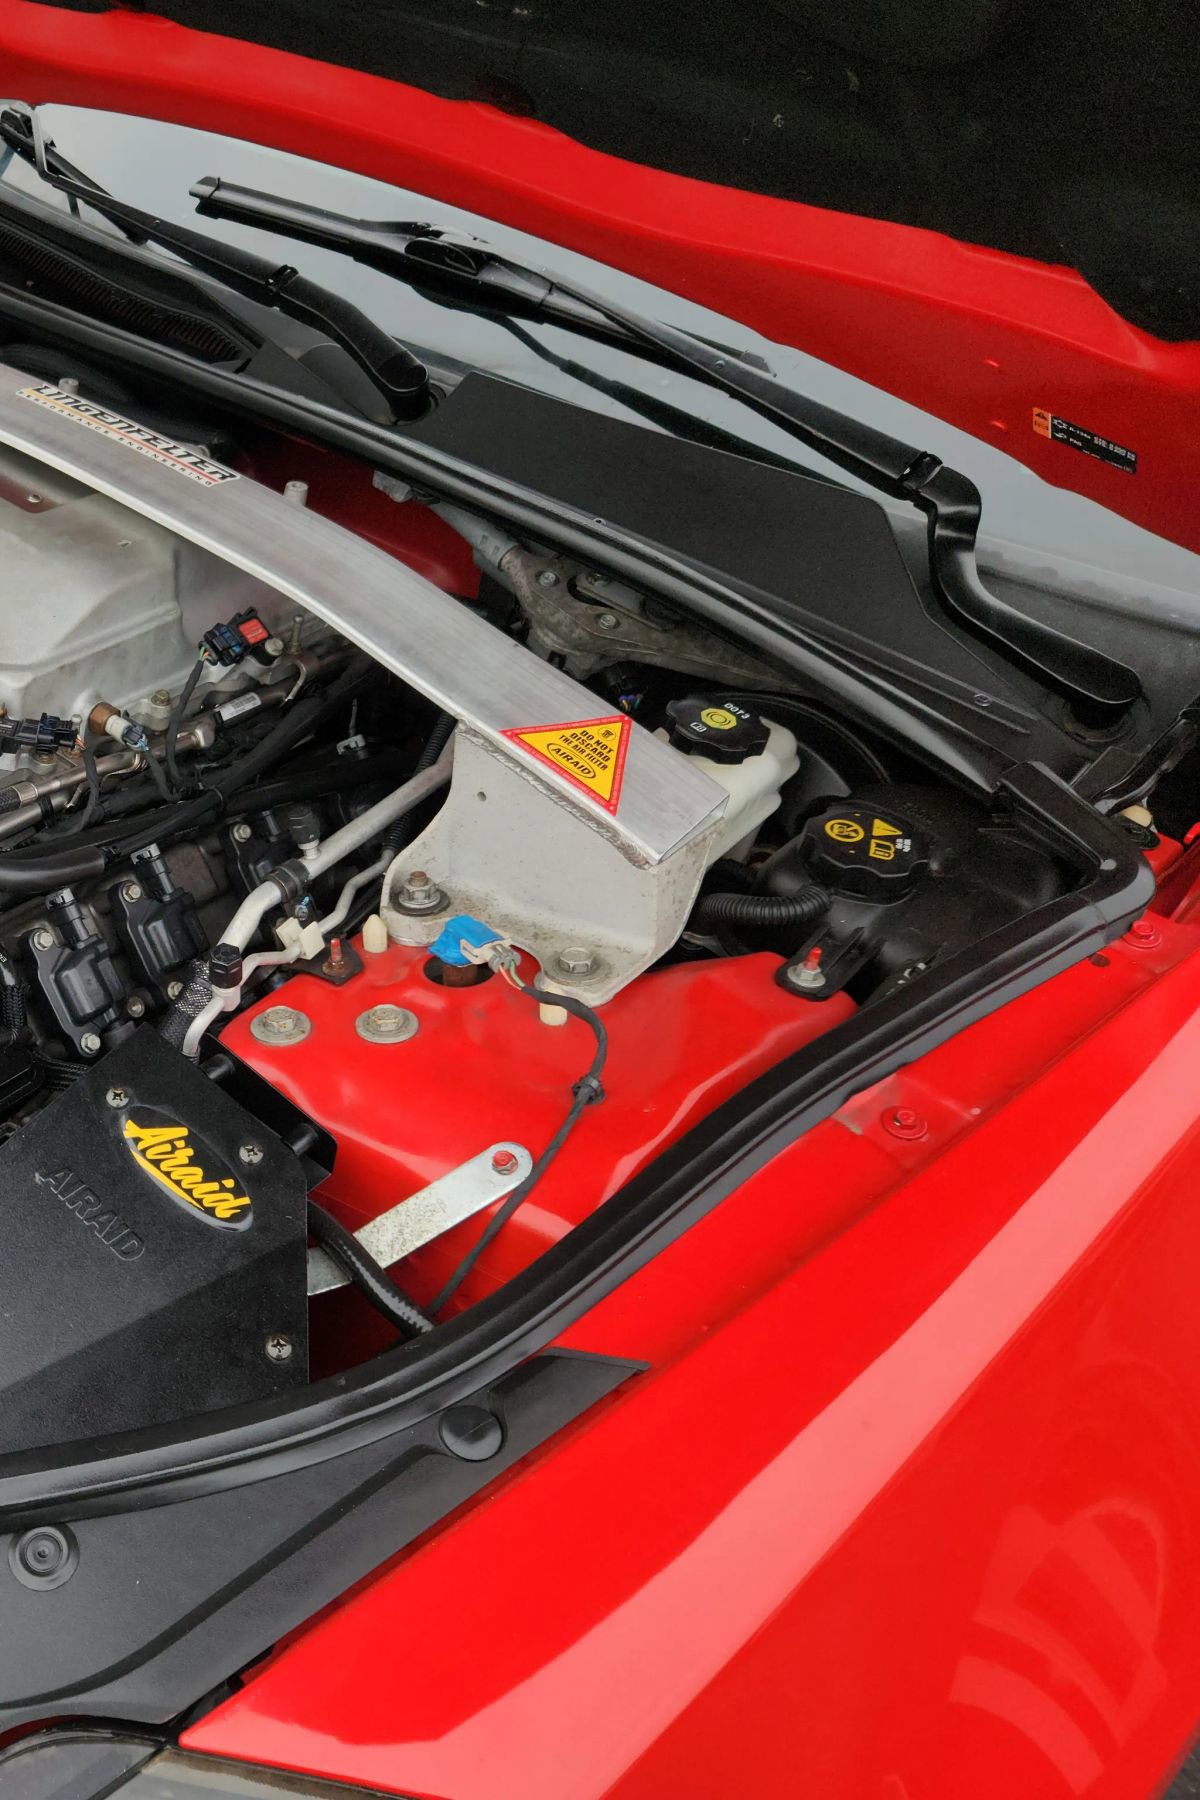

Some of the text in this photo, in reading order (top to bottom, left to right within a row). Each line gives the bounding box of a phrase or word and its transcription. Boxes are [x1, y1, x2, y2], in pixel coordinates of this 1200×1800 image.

[19, 391, 212, 485] PERFORMANCE ENGINEERING
[32, 385, 237, 480] LINGENFELTER
[551, 748, 592, 774] AIRAID
[559, 734, 608, 770] THE AIR FILTER
[570, 732, 610, 762] DISCARD
[580, 730, 614, 753] DO NOT
[123, 1119, 251, 1218] Airaid
[34, 1166, 145, 1261] AIRAID
